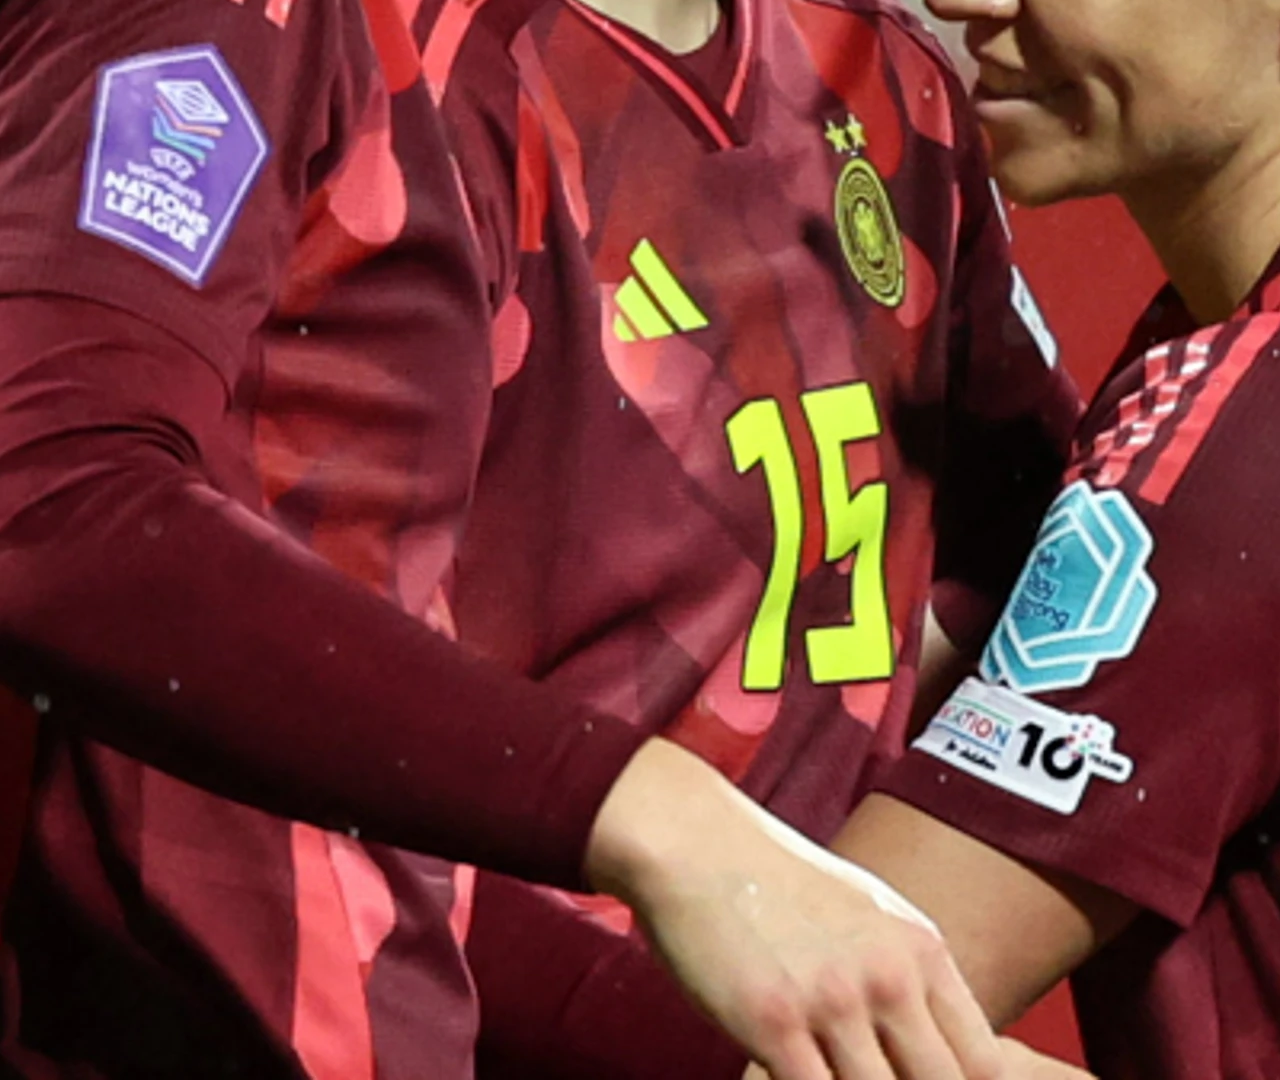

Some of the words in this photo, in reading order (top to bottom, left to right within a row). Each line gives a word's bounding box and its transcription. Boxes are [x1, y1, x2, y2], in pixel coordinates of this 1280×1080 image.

[104, 170, 211, 236] NATIONS
[105, 190, 197, 253] LEAGUE
[725, 381, 894, 691] 15
[1018, 721, 1085, 780] 10
